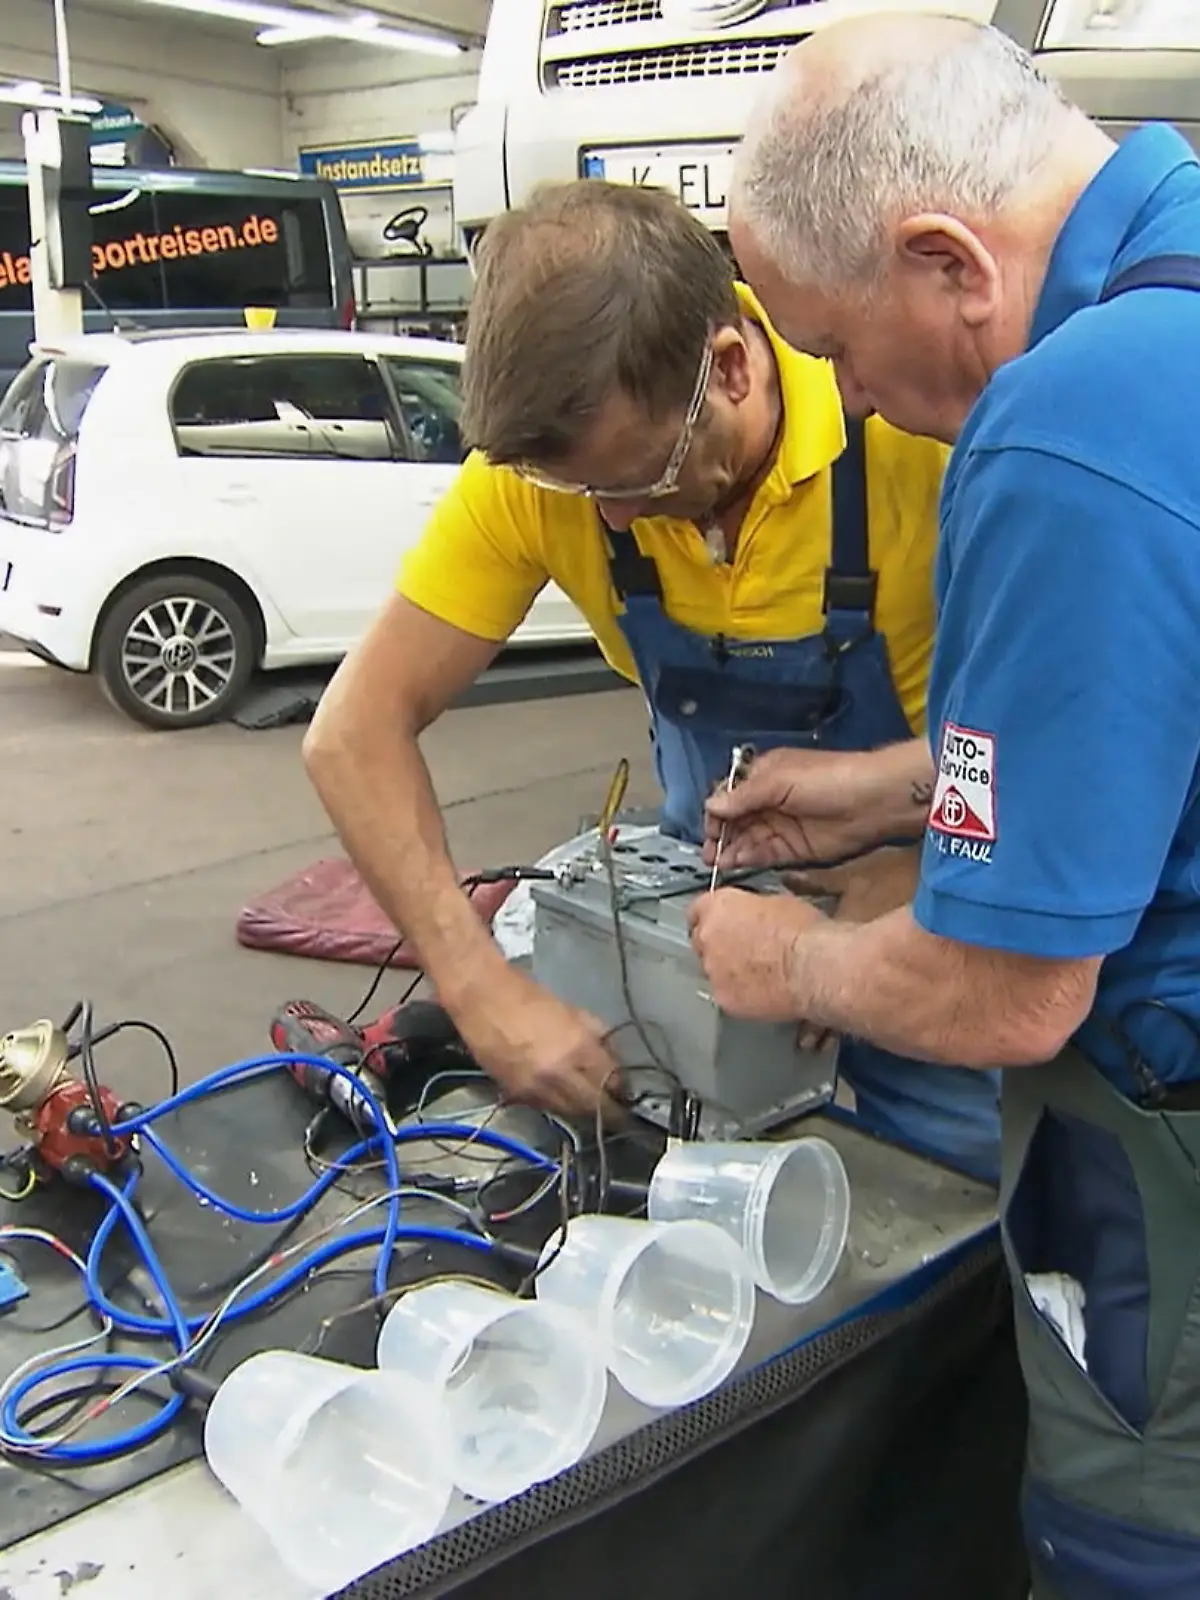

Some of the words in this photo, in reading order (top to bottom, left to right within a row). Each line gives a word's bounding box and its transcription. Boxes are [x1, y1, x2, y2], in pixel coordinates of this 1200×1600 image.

[679, 164, 725, 209] EL
[0, 251, 32, 287] ela
[950, 837, 993, 864] FAUL
